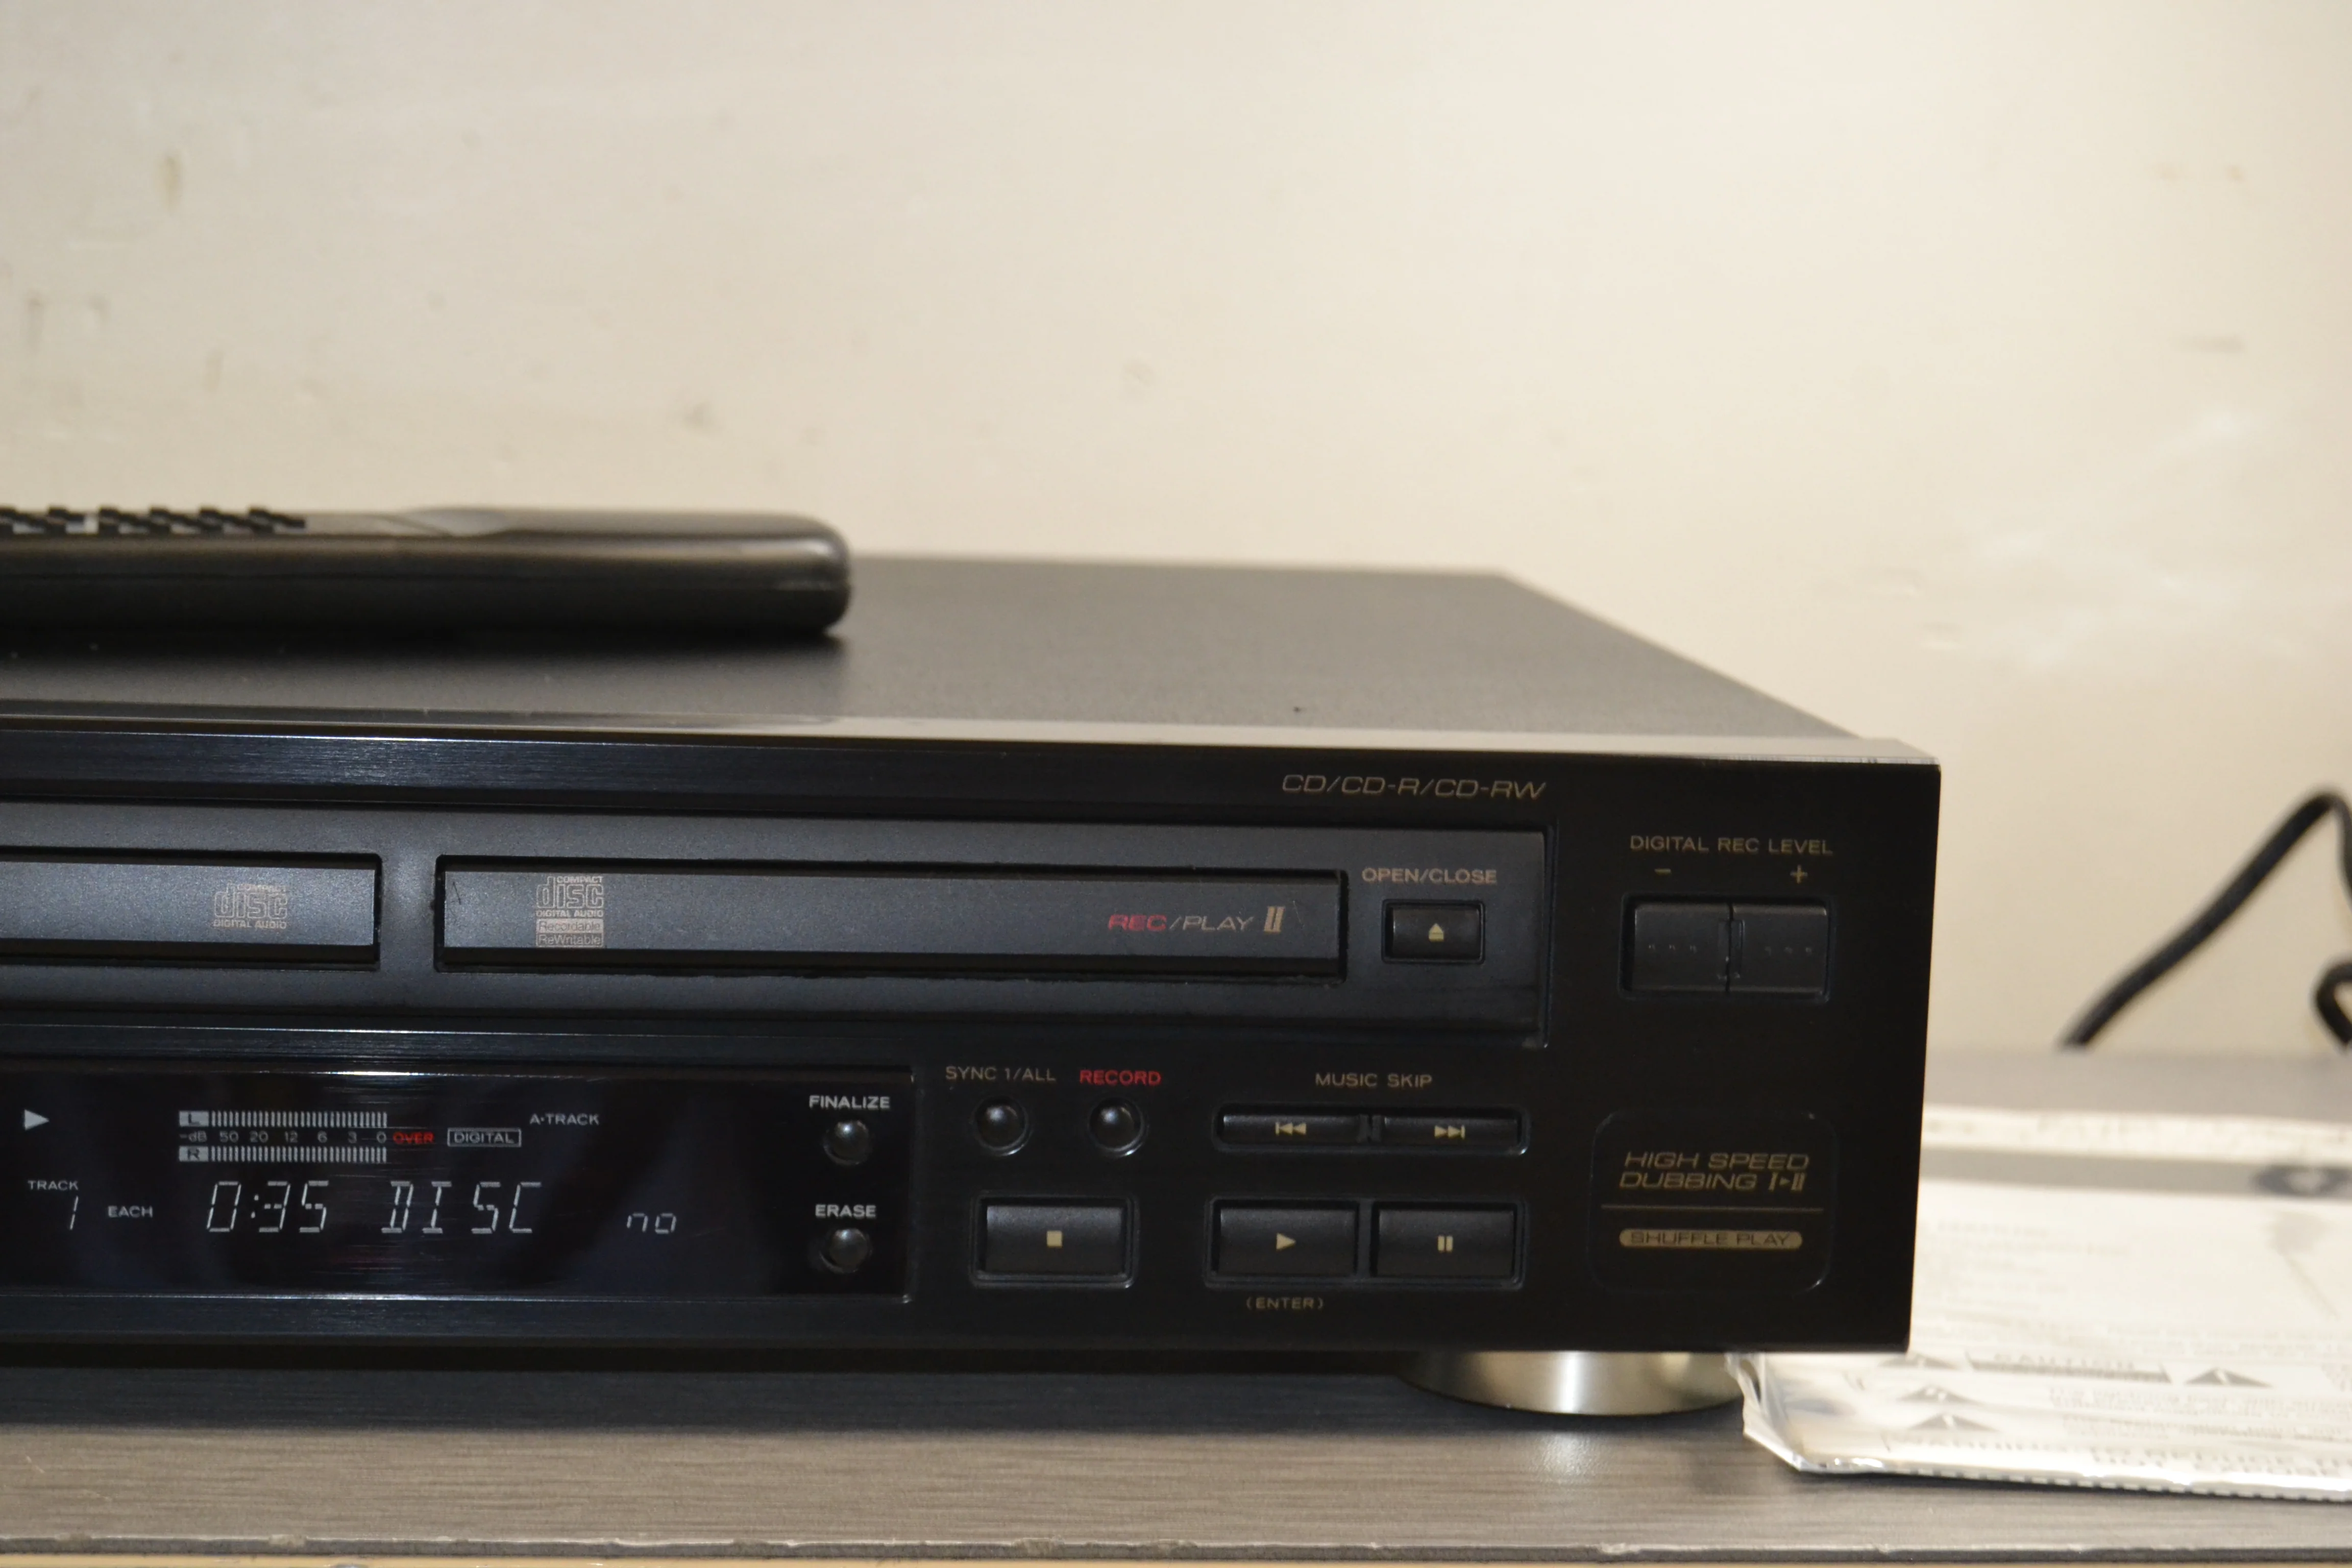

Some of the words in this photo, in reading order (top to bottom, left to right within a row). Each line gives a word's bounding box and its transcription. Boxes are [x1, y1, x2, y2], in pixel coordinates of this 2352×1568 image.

[1282, 774, 1547, 799] CD/CD-R/CD-RW
[1630, 835, 1709, 851] DIGITAL
[1718, 837, 1759, 852] REC
[1768, 838, 1833, 855] LEVEL
[1362, 867, 1497, 884] OPEN/CLOSE
[536, 876, 604, 909] disc
[213, 919, 252, 928] DIGITAL
[255, 920, 287, 929] AUDIO
[539, 921, 601, 931] Recordable
[539, 934, 601, 945] ReWritable
[945, 1066, 996, 1082] SYNC
[1004, 1067, 1056, 1082] 1/ALL
[1080, 1070, 1162, 1086] RECORD
[1315, 1073, 1377, 1087] MUSIC
[1387, 1074, 1432, 1088] SKIP
[808, 1095, 890, 1110] FINALIZE
[219, 1131, 239, 1143] 50
[250, 1131, 269, 1143] 20
[285, 1131, 298, 1143] 12
[317, 1131, 328, 1143] 6
[348, 1131, 357, 1143] 3
[376, 1131, 387, 1144] 0
[393, 1131, 435, 1144] OVER
[454, 1132, 514, 1144] DIGITAL
[1625, 1152, 1700, 1168] HIGH
[1708, 1153, 1809, 1170] SPEED
[28, 1180, 79, 1191] TRACK
[1619, 1172, 1757, 1190] DUBBING
[108, 1206, 153, 1218] EACH
[207, 1181, 329, 1233] 0:35
[381, 1181, 542, 1234] DISC
[815, 1205, 876, 1218] ERASE
[1631, 1232, 1728, 1245] SHUFFLE
[1737, 1232, 1790, 1245] PLAY
[1246, 1297, 1324, 1310] (ENTER)
